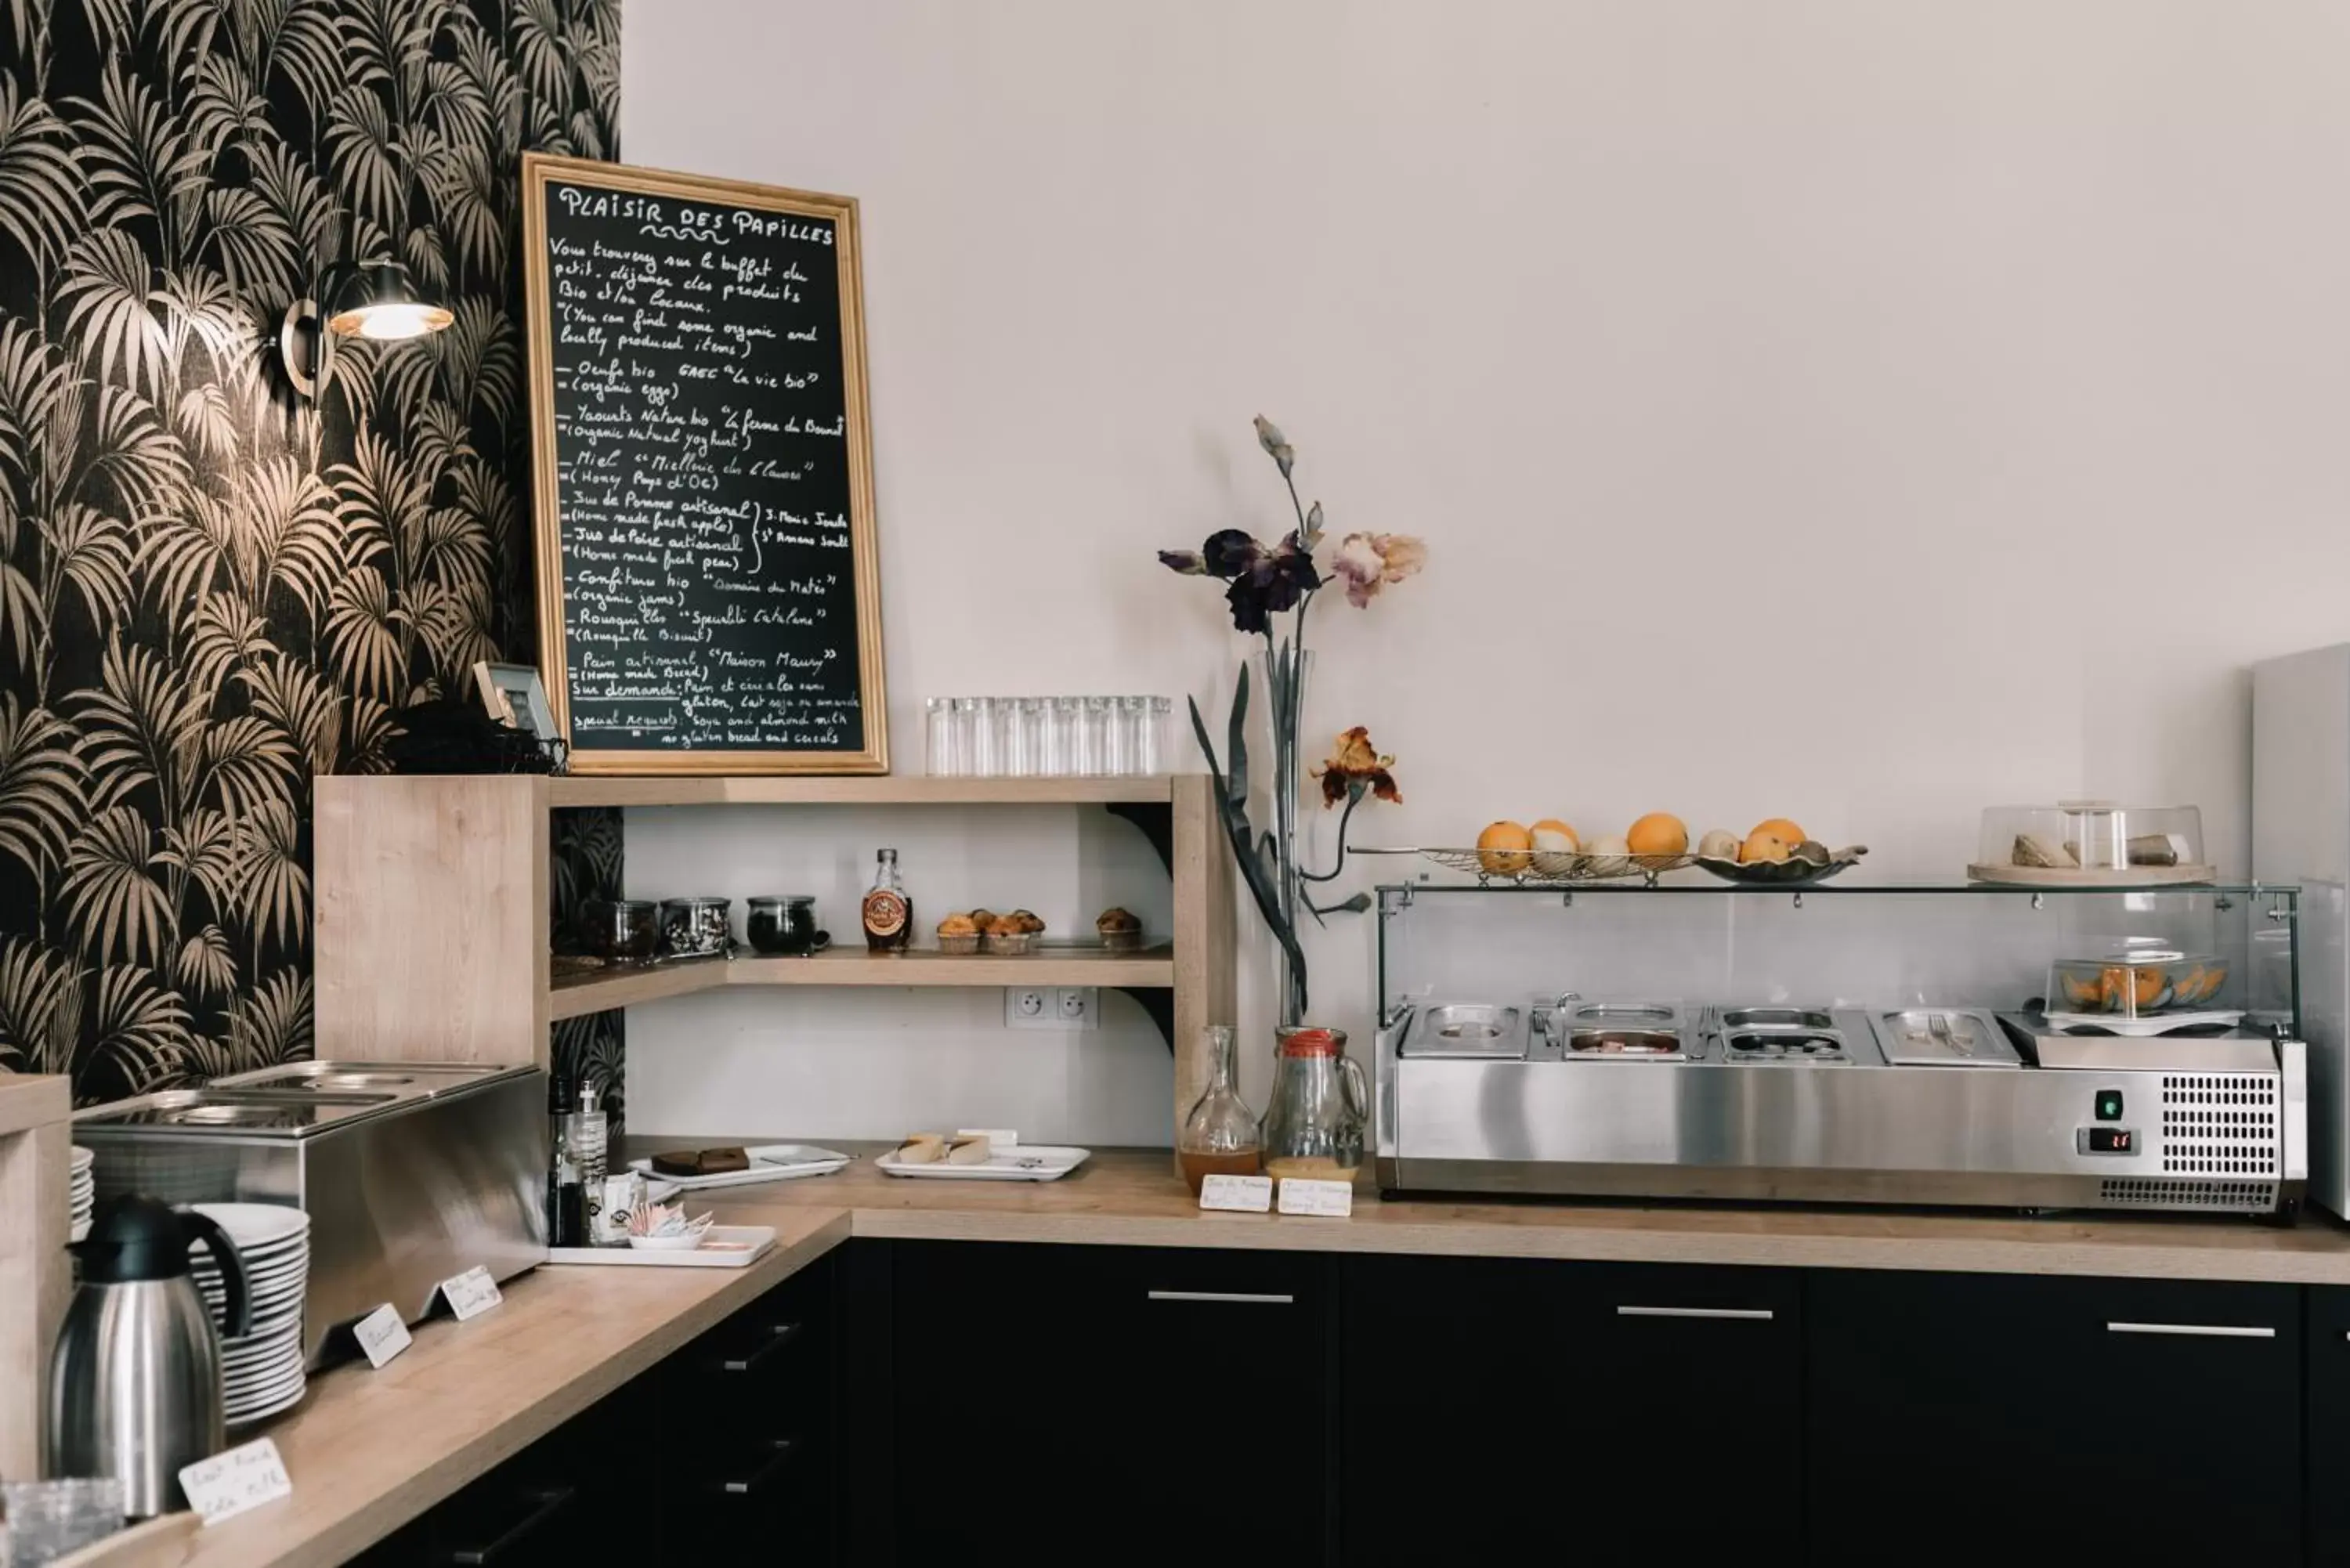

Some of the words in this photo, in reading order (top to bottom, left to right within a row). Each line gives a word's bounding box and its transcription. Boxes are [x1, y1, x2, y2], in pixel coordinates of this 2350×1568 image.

[680, 208, 723, 229] DES
[550, 237, 586, 255] Vous
[593, 240, 656, 274] trouverez
[664, 256, 691, 267] sur
[701, 251, 714, 269] le
[721, 255, 772, 282] buffet
[783, 262, 808, 282] du
[559, 280, 587, 299] Bio
[683, 274, 712, 291] des
[723, 283, 801, 303] produits
[602, 313, 624, 323] can
[633, 309, 667, 334] find
[678, 320, 714, 333] some
[723, 324, 777, 343] organic
[787, 325, 818, 341] and
[560, 323, 608, 357] locally
[618, 334, 684, 351] produced
[578, 358, 624, 385] Oeufs
[631, 358, 656, 378] bio
[678, 363, 718, 379] GAEC
[755, 370, 778, 388] vie
[572, 377, 632, 403] (organic
[641, 381, 679, 406] eggs)
[577, 403, 632, 422] Yaourts
[641, 406, 686, 425] Nature
[690, 406, 709, 427] bio
[742, 408, 779, 436] ferme
[784, 415, 800, 433] du
[628, 423, 681, 443] Natural
[577, 449, 622, 468] Miel
[570, 468, 622, 491] (Honey
[633, 470, 662, 493] Pays
[573, 490, 598, 506] Jus
[602, 489, 620, 507] de
[625, 490, 674, 509] Pomme
[681, 496, 750, 518] artisanal
[613, 511, 651, 525] made
[653, 511, 688, 531] fresh
[573, 527, 603, 541] Jus
[609, 527, 627, 544] de
[627, 529, 663, 547] Poire
[669, 533, 743, 551] artisanal
[623, 551, 658, 563] made
[663, 549, 695, 571] fresh
[667, 572, 689, 588] bio
[638, 589, 685, 613] jams)
[584, 651, 615, 669] Pain
[627, 649, 696, 667] artisanal
[624, 667, 658, 680] made
[573, 681, 600, 695] Sur
[684, 678, 714, 694] Pain
[721, 676, 734, 692] et
[728, 712, 754, 725] and
[761, 711, 808, 725] almond
[815, 710, 847, 725] milk
[662, 735, 678, 743] no
[728, 727, 761, 742] bread
[766, 730, 788, 742] and
